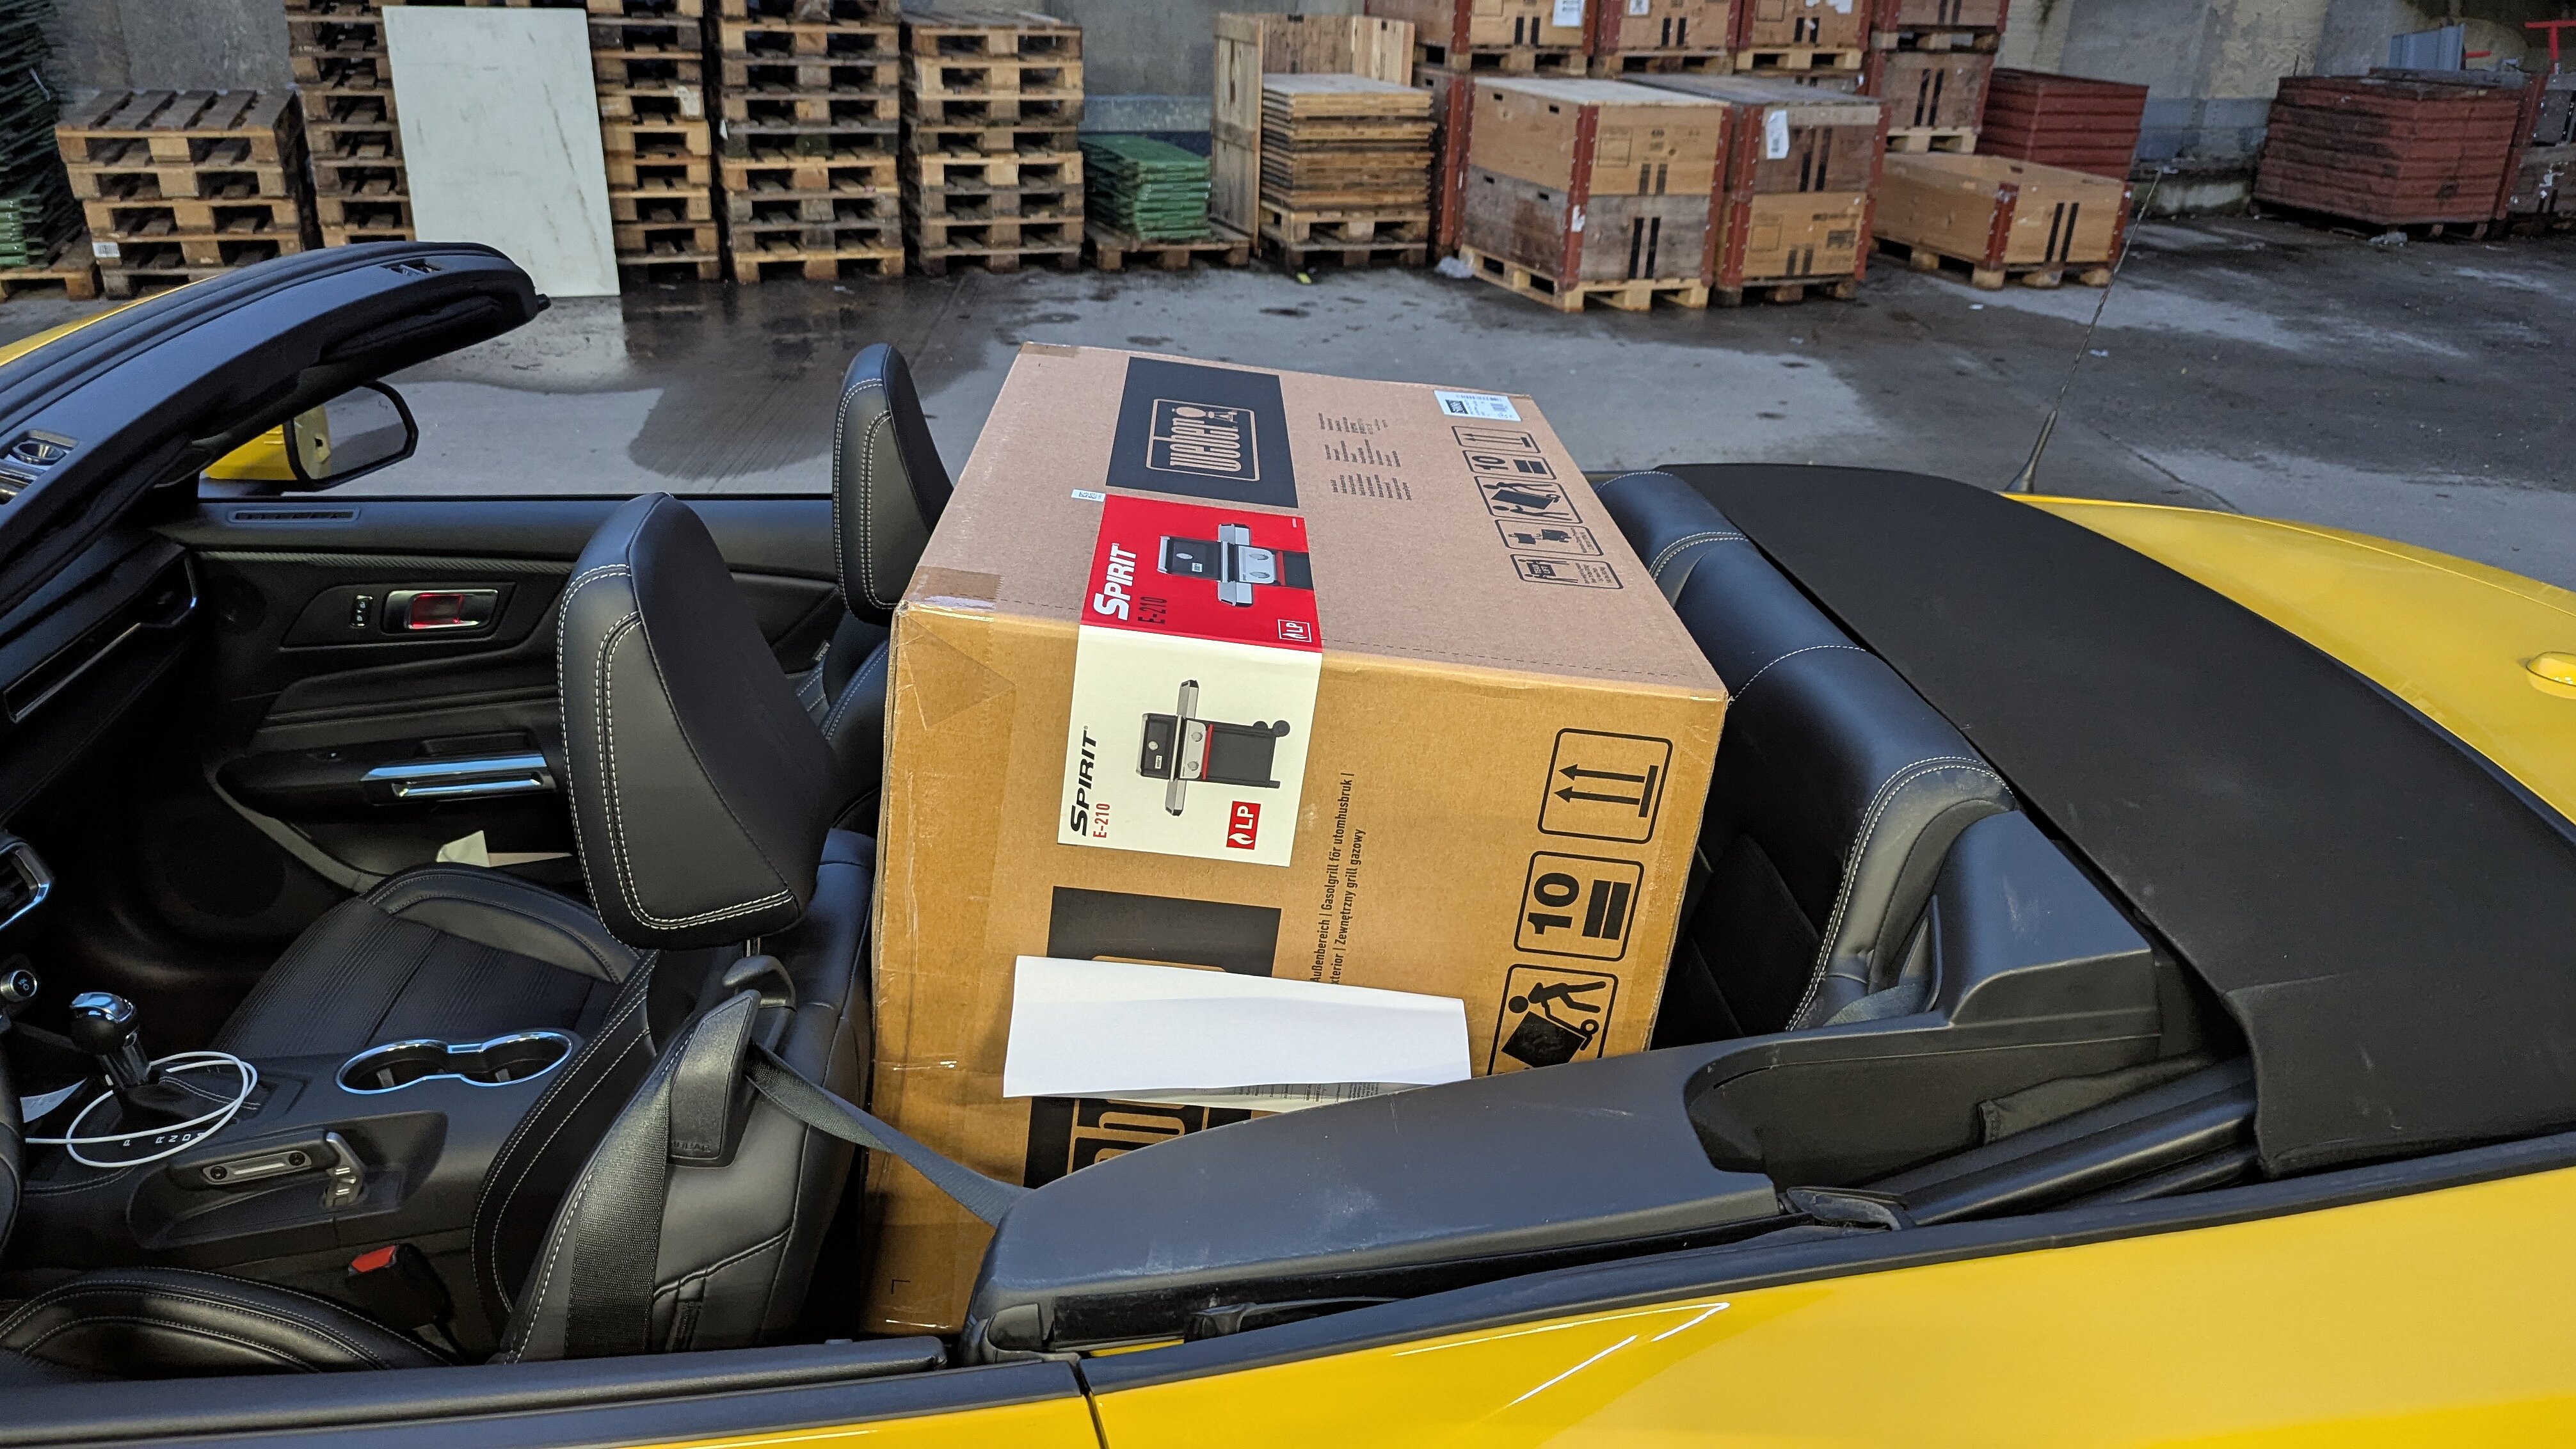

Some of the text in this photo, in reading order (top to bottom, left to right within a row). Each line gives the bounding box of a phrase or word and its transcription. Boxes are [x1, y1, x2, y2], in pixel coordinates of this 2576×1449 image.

[1154, 418, 1242, 472] weber
[1472, 456, 1508, 470] 10
[1138, 596, 1167, 624] E-210
[1286, 622, 1304, 633] LP
[1093, 803, 1110, 838] E-210
[1235, 806, 1254, 829] LP
[1332, 779, 1353, 845] utomhusbruk
[1329, 846, 1341, 861] för
[1350, 829, 1366, 866] gazowy
[1321, 864, 1340, 911] Gasolgrill
[1345, 868, 1358, 888] grill
[1334, 890, 1357, 945] Zewnętrzny
[1526, 872, 1580, 935] 10
[1310, 919, 1331, 982] Außenbereich
